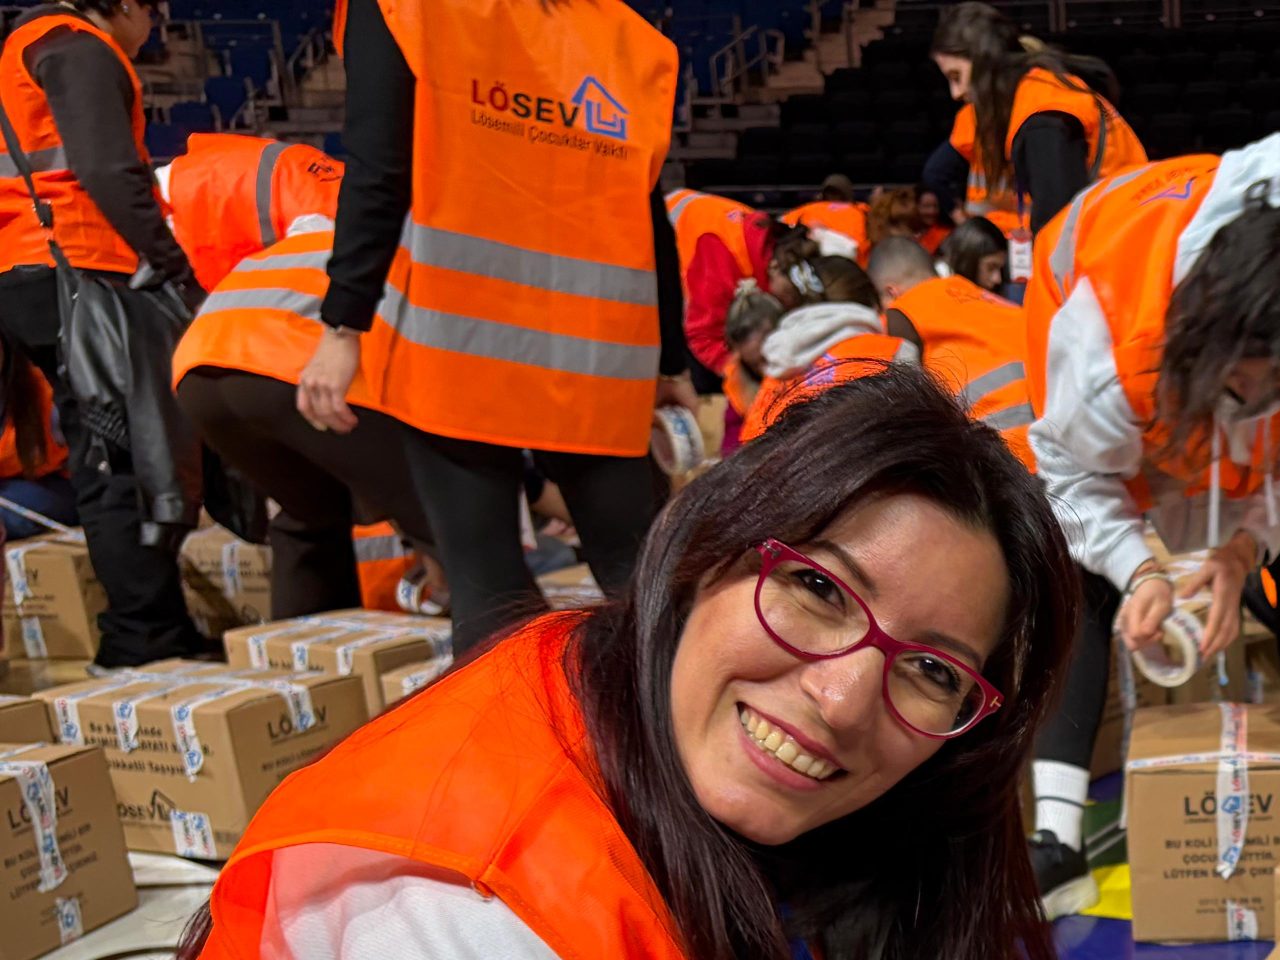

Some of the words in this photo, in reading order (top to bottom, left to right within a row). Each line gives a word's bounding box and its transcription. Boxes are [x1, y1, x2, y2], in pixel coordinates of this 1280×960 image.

[471, 79, 580, 128] LÖSEV
[267, 705, 328, 740] LÖV
[1184, 791, 1274, 817] LÖEV
[1183, 853, 1218, 865] ÇOCU
